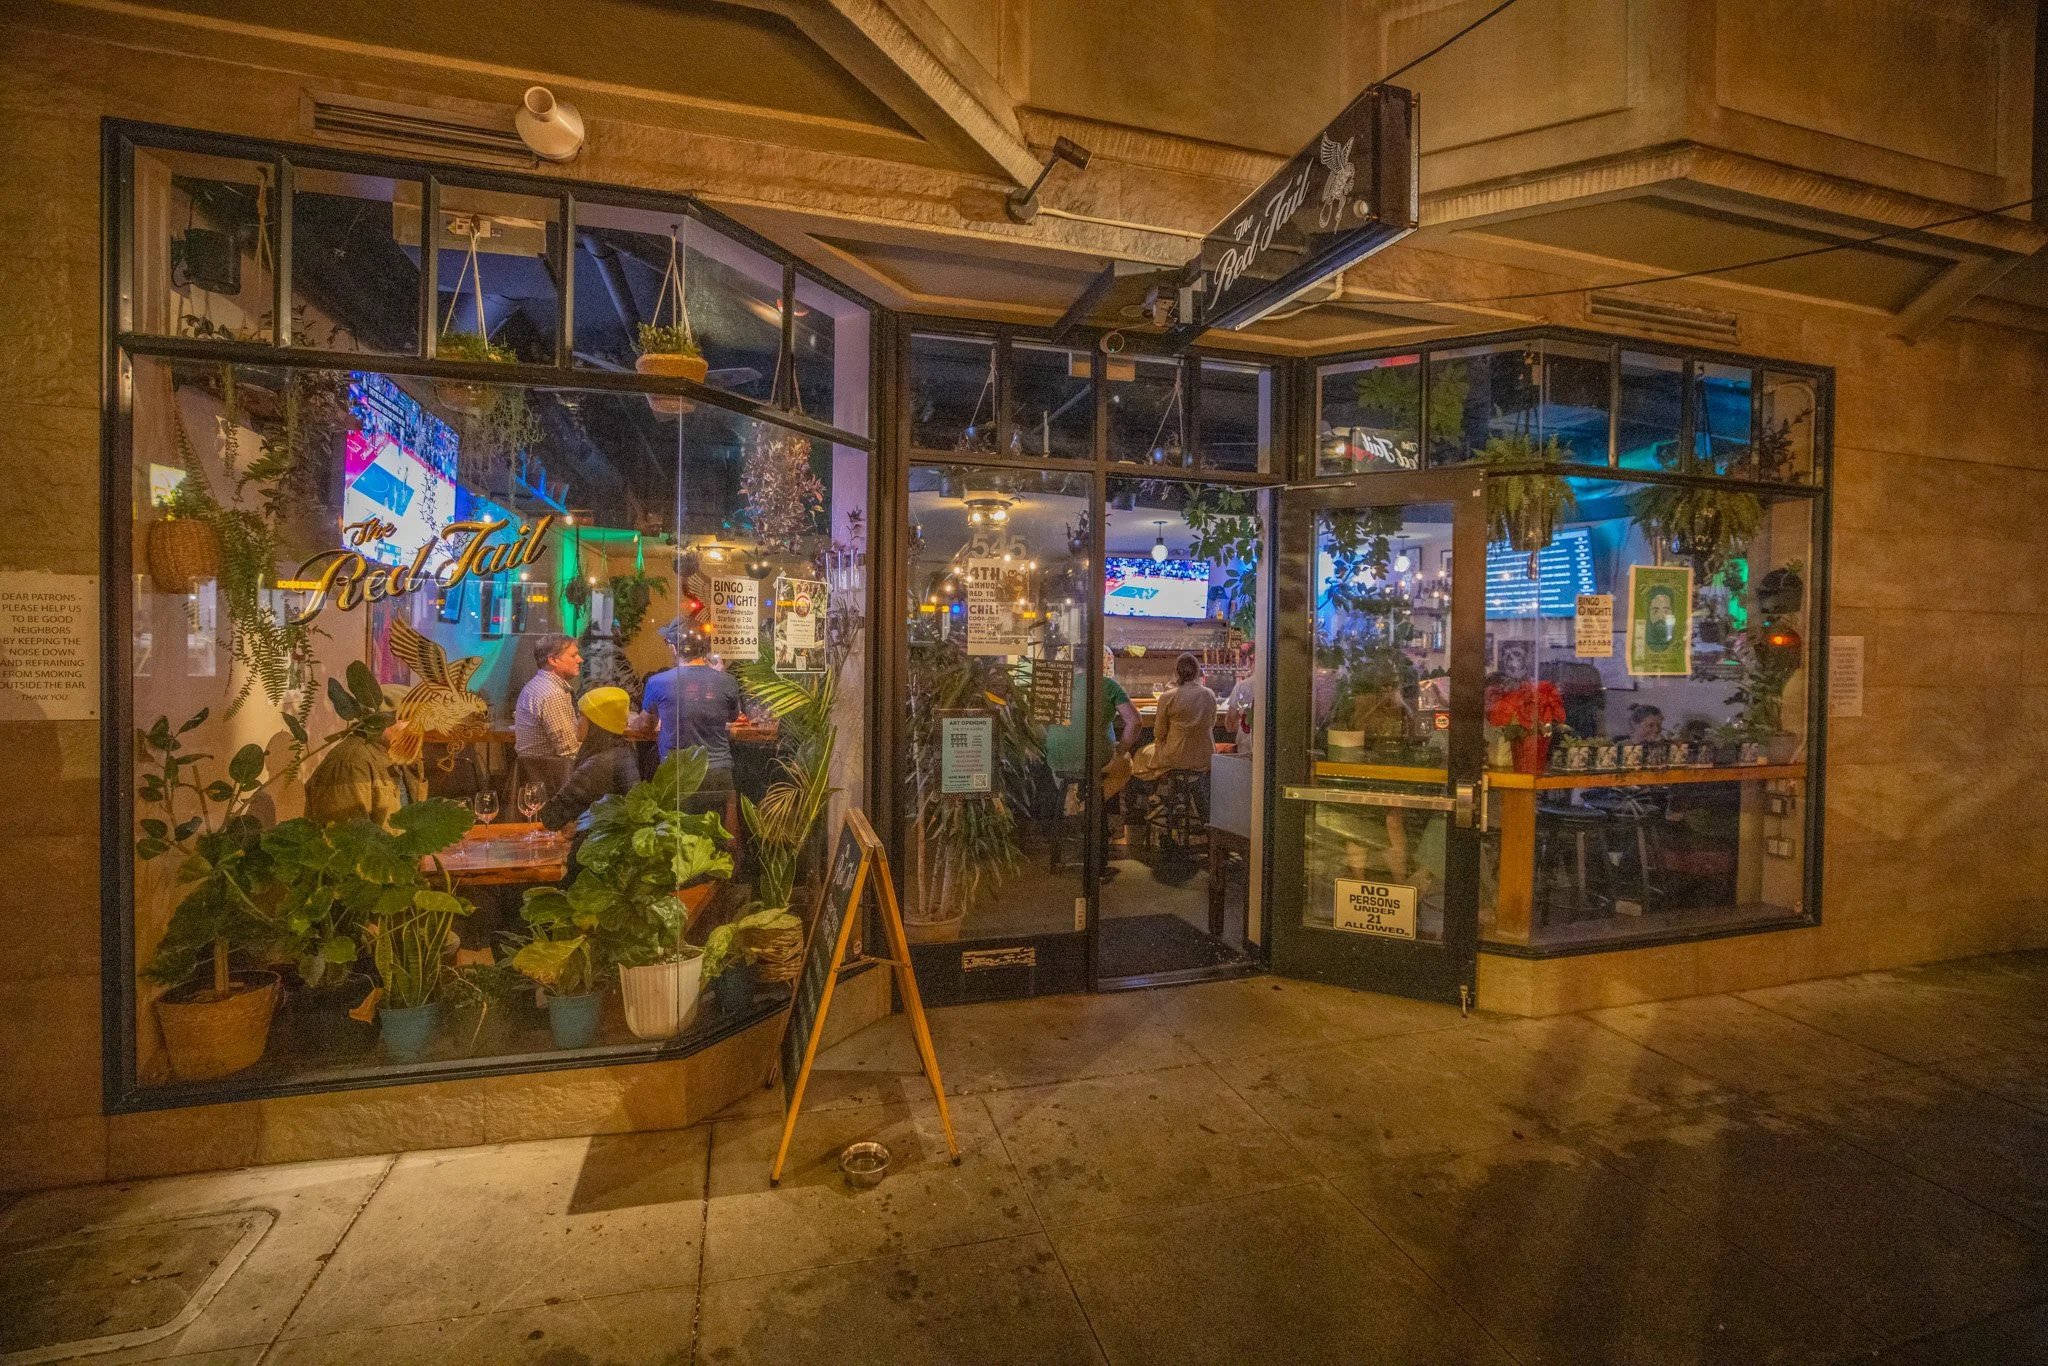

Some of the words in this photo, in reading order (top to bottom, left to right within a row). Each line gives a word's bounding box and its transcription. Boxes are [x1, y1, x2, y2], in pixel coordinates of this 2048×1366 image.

[1209, 221, 1263, 310] Red
[1261, 158, 1314, 250] Tail
[1234, 215, 1254, 241] The
[343, 518, 397, 546] The
[971, 534, 1027, 559] 545
[288, 536, 438, 625] Red
[435, 514, 554, 589] Tail
[970, 567, 1000, 580] 4TH
[714, 581, 743, 593] BINGO
[727, 595, 757, 607] NIGHT!
[1578, 597, 1600, 606] BINGO
[2, 604, 38, 612] PLEASE
[11, 615, 25, 623] TO
[27, 615, 39, 623] BE
[13, 626, 71, 634] NEIGHBORS
[2, 637, 15, 645] BY
[0, 659, 23, 667] AND
[25, 659, 85, 667] REFRAINING
[2, 670, 32, 678] FROM
[35, 670, 82, 678] SMOKING
[0, 681, 43, 689] OUTSIDE
[44, 681, 63, 689] THE
[65, 681, 87, 689] BAR.
[1360, 885, 1389, 897] NO
[1349, 894, 1400, 909] PERSONS
[1354, 905, 1396, 916] UNDER
[1367, 913, 1382, 924] 21
[1344, 920, 1405, 935] ALLOWED
